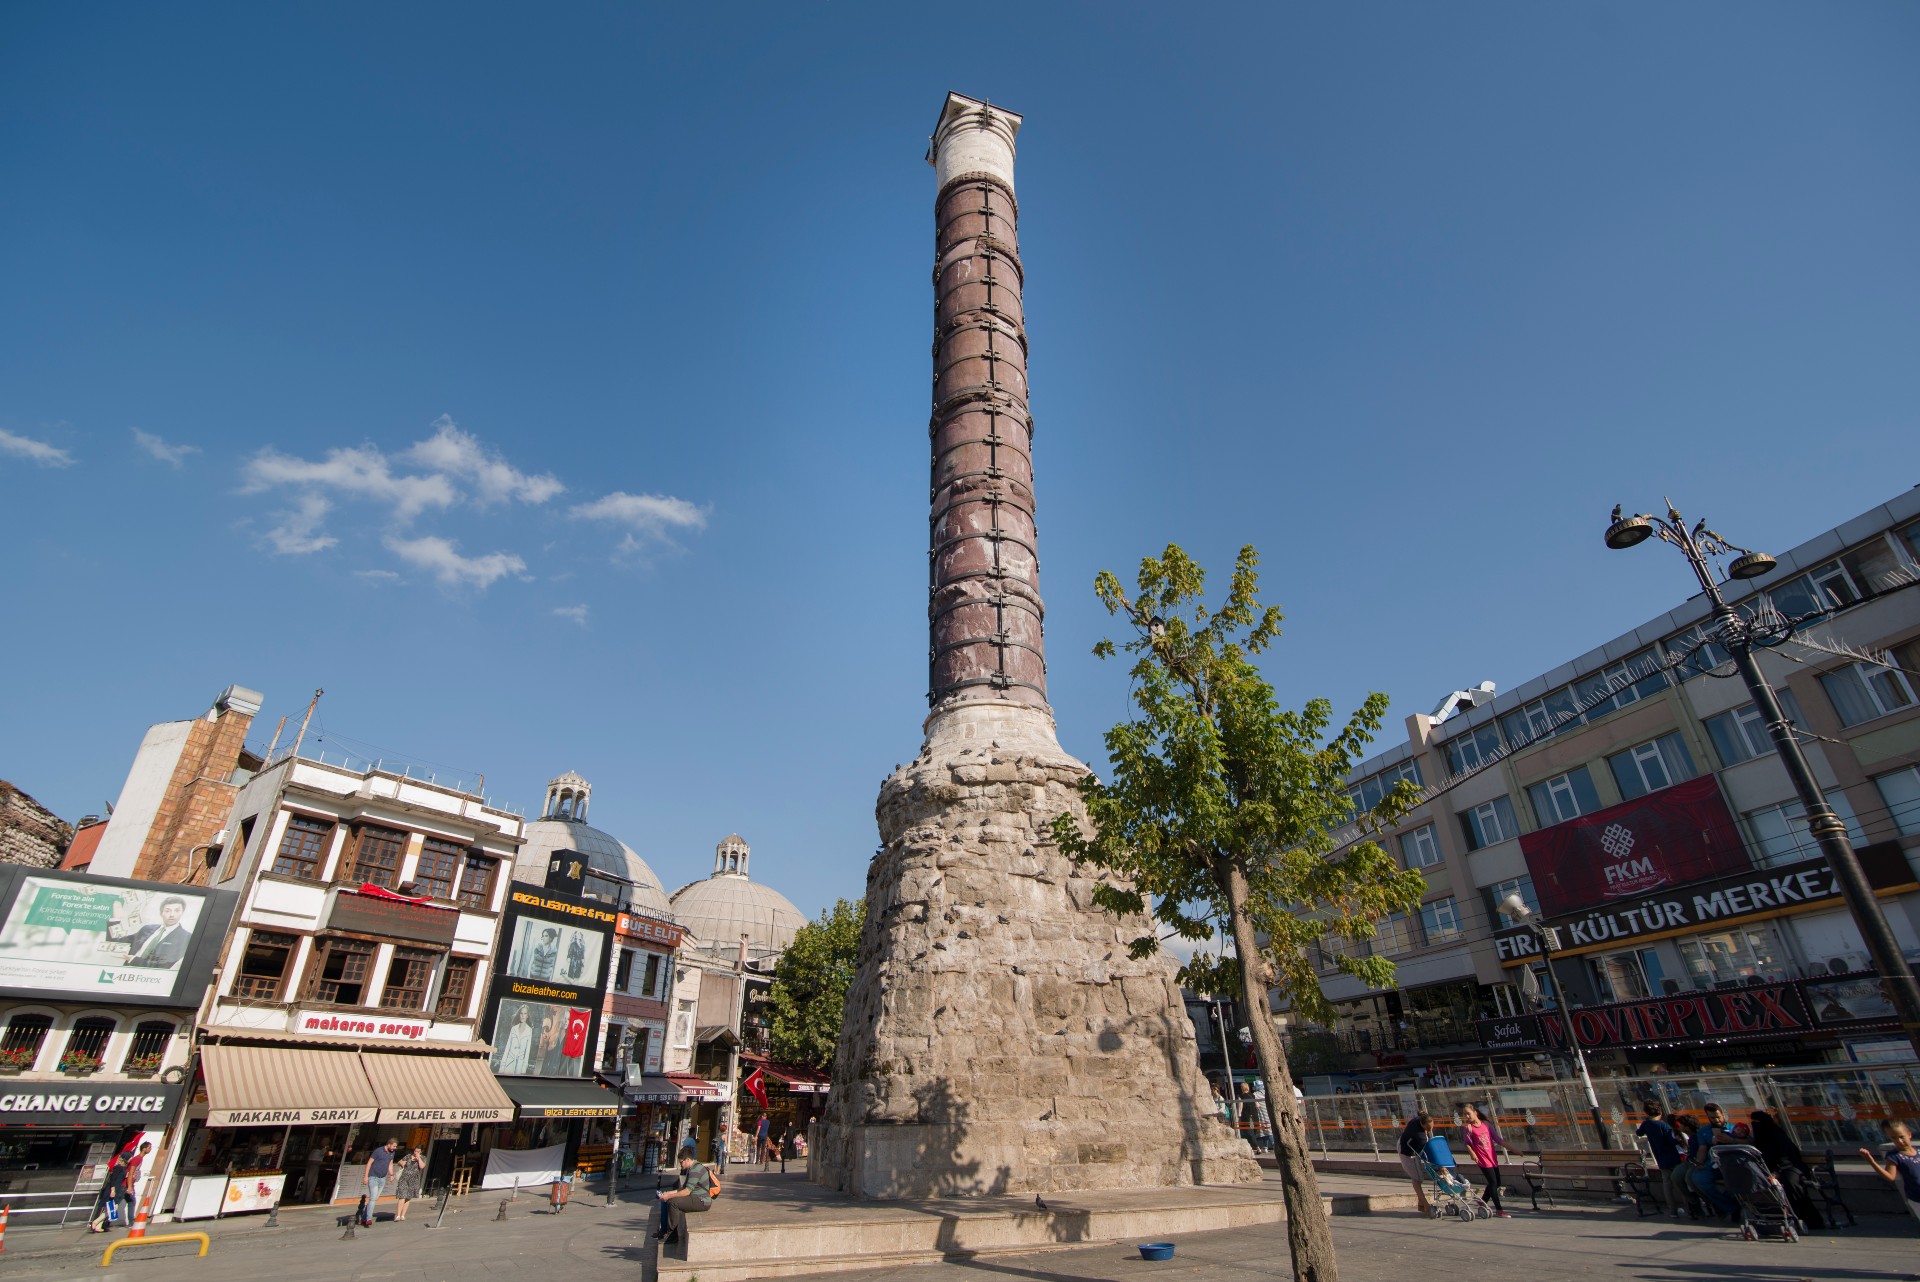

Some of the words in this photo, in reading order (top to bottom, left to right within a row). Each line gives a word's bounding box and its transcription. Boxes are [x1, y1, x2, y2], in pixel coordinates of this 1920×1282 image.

[1603, 856, 1655, 885] FKM
[587, 908, 595, 918] &
[594, 911, 616, 923] FUR
[1569, 900, 1690, 946] KÜLTÜR
[620, 917, 652, 935] BÜFE
[654, 926, 679, 941] ELİT
[112, 973, 135, 983] ALB
[135, 974, 162, 985] Forex
[512, 982, 578, 1000] ibizaleather.com
[1541, 987, 1803, 1049] MOVIEPLEX
[304, 1016, 375, 1033] makarna
[378, 1023, 425, 1039] sarayı
[1494, 1023, 1522, 1039] Şafak
[0, 1094, 92, 1112] CHANGE
[94, 1095, 166, 1112] OFFICE
[564, 1108, 597, 1116] LEATHER
[228, 1111, 301, 1123] MAKARNA
[310, 1110, 359, 1121] SARAYI
[396, 1110, 448, 1120] FALAFEL
[449, 1111, 457, 1120] &
[460, 1110, 499, 1120] HUMUS
